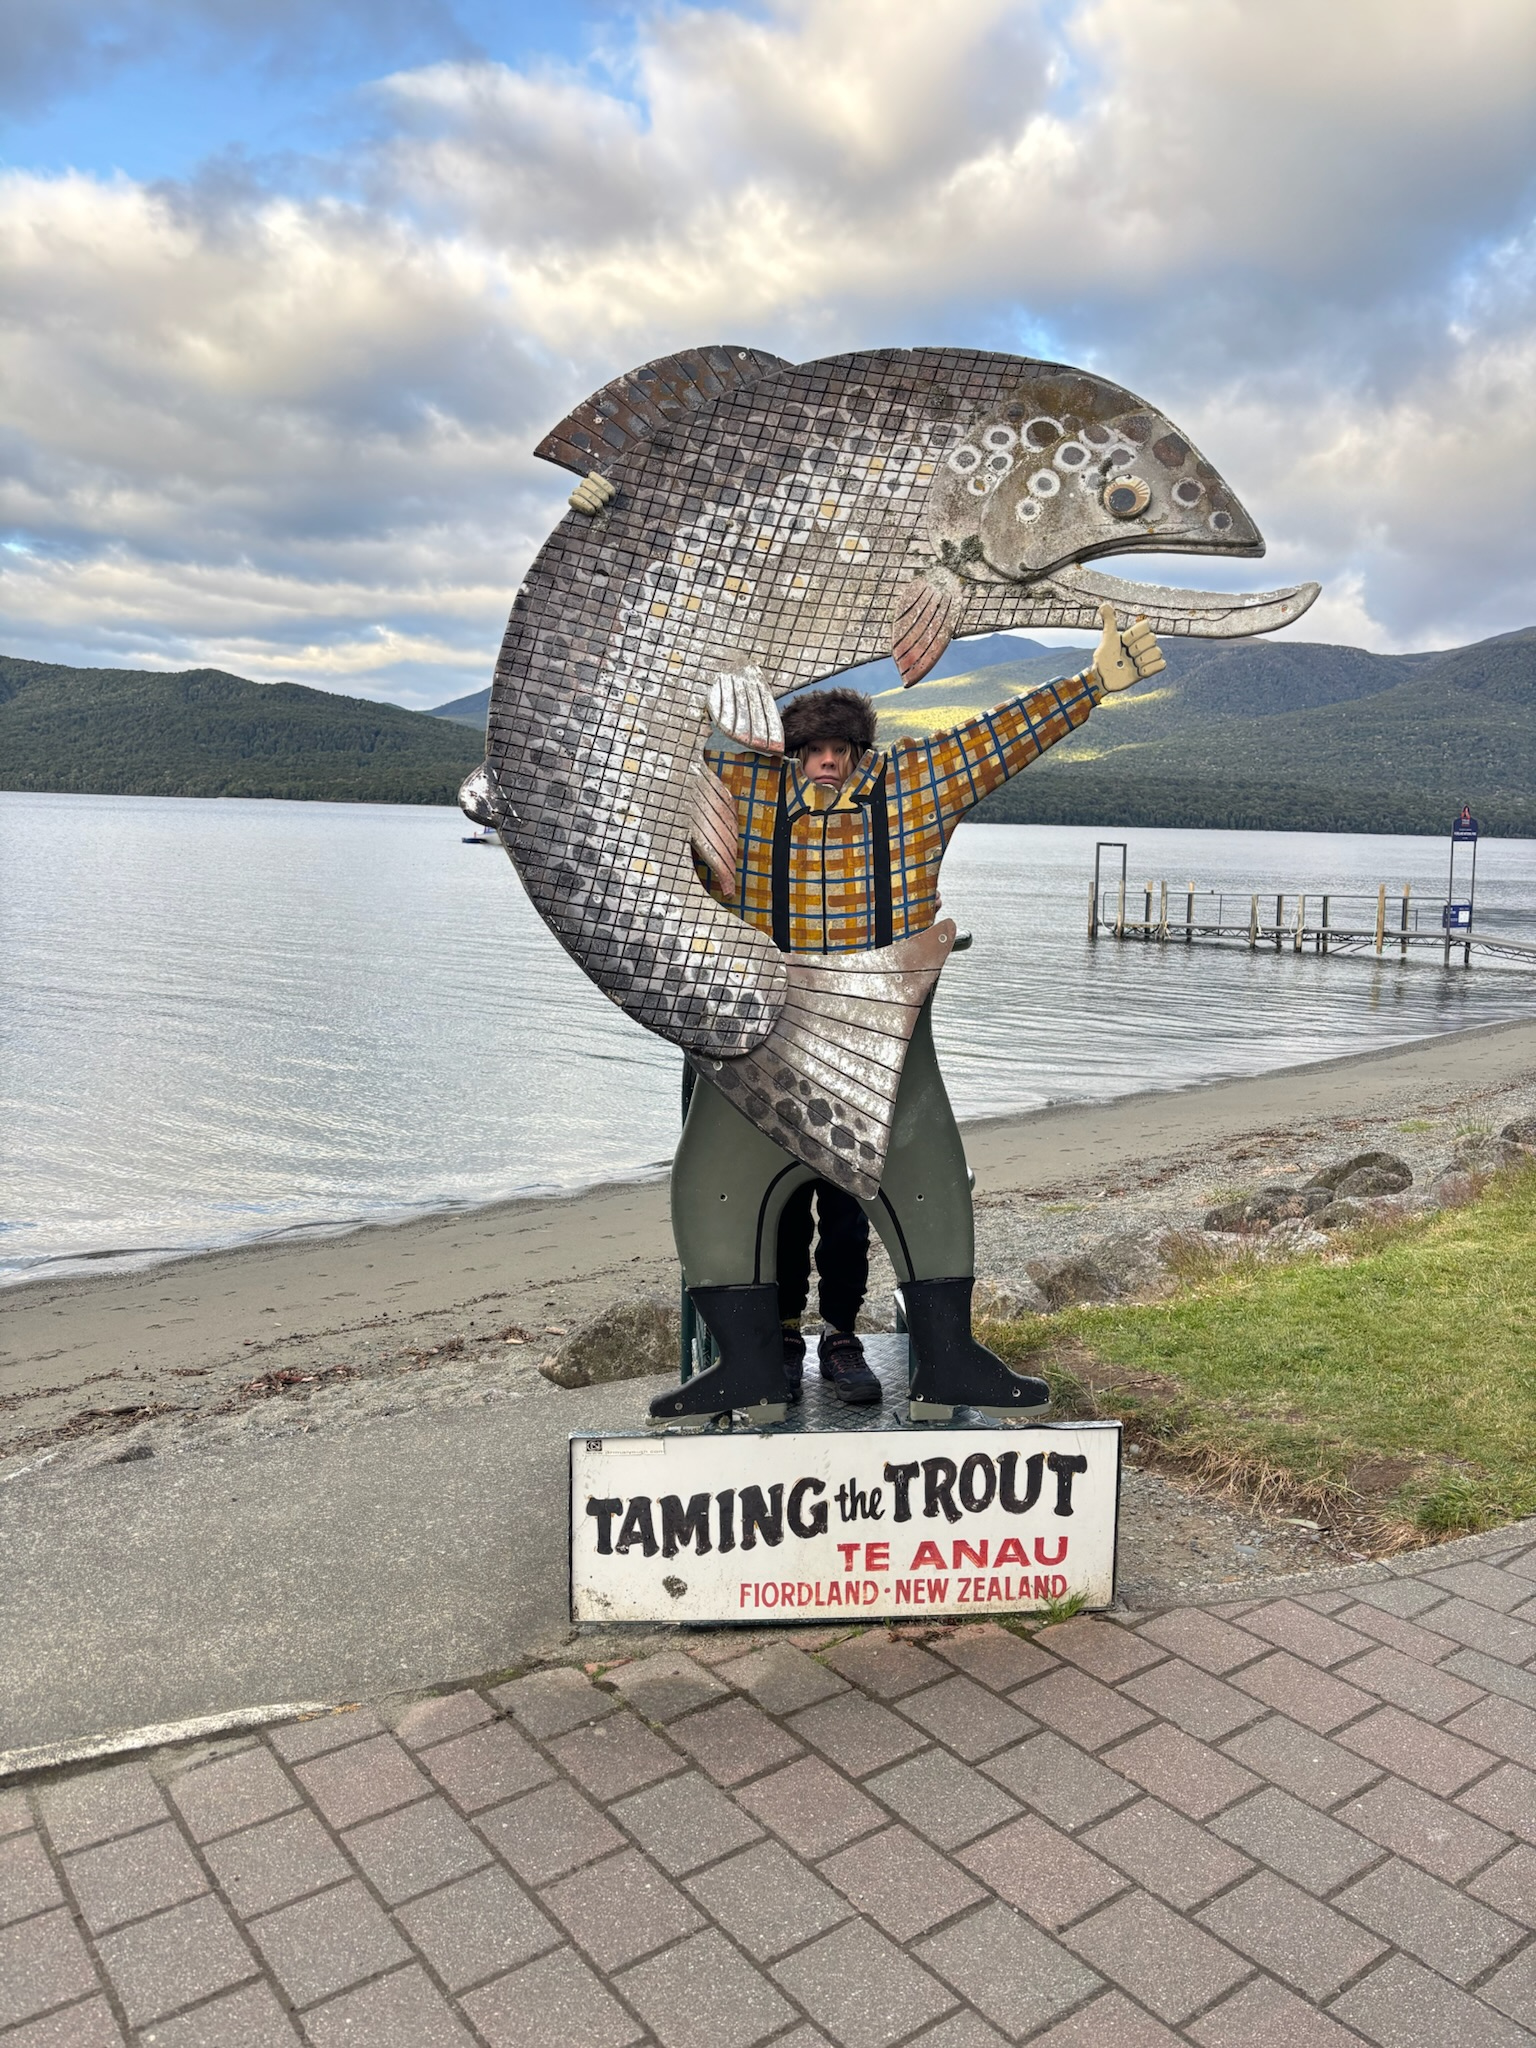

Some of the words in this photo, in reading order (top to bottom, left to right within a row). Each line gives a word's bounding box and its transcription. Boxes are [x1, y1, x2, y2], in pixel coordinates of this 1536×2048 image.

[585, 1478, 828, 1559] TAMING
[834, 1477, 885, 1523] the
[884, 1452, 1088, 1524] TROUT
[837, 1541, 890, 1573] TE
[910, 1536, 1068, 1571] ANAU
[740, 1579, 879, 1608] FIORDLAND
[896, 1578, 948, 1605] NEW
[958, 1573, 1068, 1603] ZEALAND
